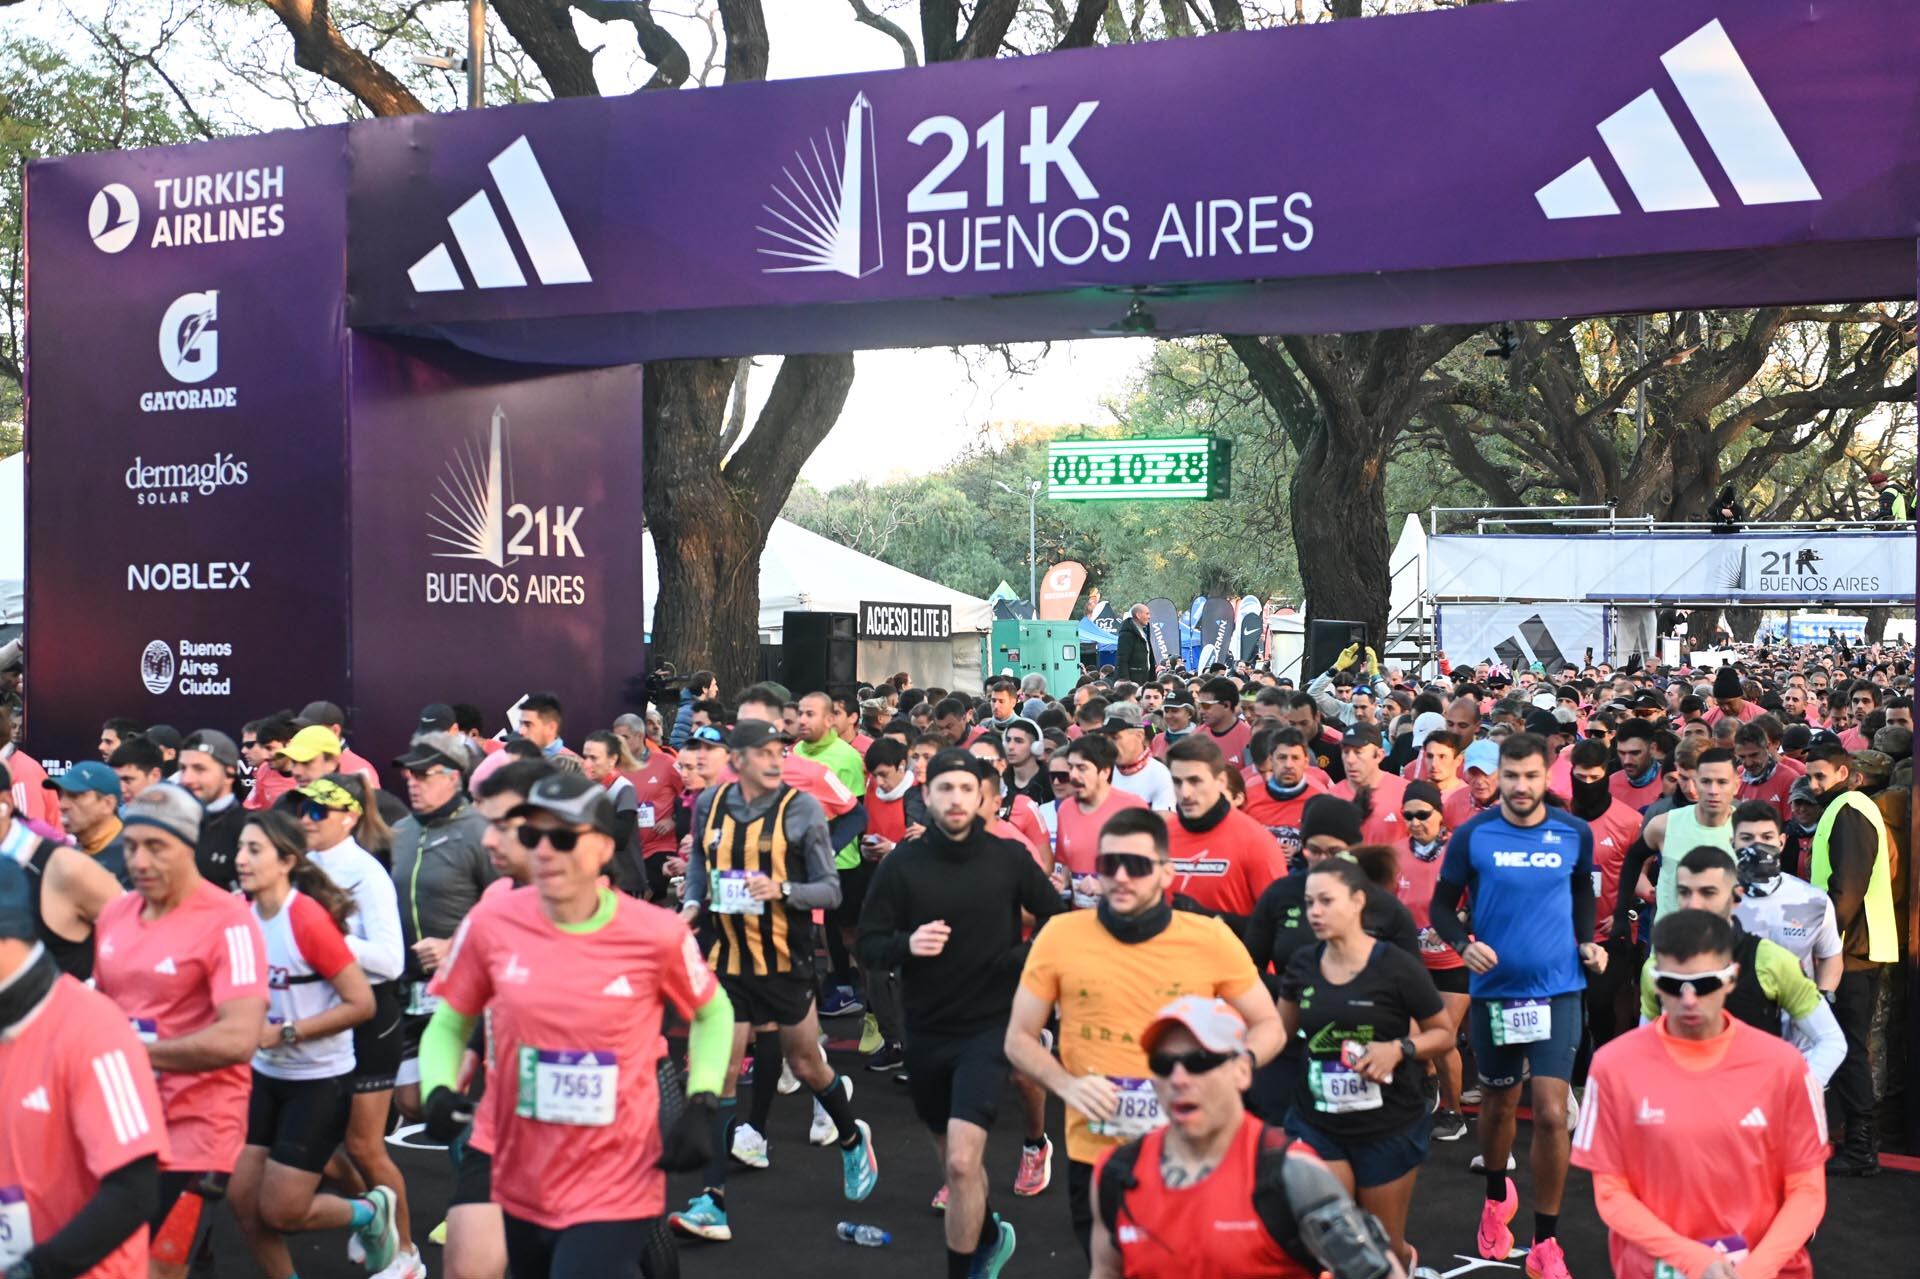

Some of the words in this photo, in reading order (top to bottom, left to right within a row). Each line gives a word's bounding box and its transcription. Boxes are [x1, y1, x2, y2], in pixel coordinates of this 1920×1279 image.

[907, 101, 1100, 213] 21K
[154, 165, 284, 211] TURKISH
[151, 203, 285, 248] AIRLINES
[906, 207, 1131, 276] BUENOS
[1149, 191, 1314, 260] AIRES
[140, 387, 237, 412] GATORADE
[125, 452, 249, 496] dermaglós
[137, 491, 190, 505] SOLAR
[506, 503, 585, 558] 21K
[127, 562, 251, 591] NOBLEX
[426, 572, 520, 604] BUENOS
[524, 574, 585, 605] AIRES
[1760, 576, 1828, 592] BUENOS
[1832, 576, 1880, 592] AIRES
[866, 606, 909, 636] ACCESO
[911, 608, 940, 637] ELITE
[941, 610, 950, 638] B
[179, 640, 232, 656] Buenos
[179, 659, 219, 676] Aires
[179, 678, 231, 695] Ciudad
[1513, 1010, 1538, 1028] 6118
[552, 1072, 602, 1099] 7563
[1330, 1079, 1368, 1097] 6764
